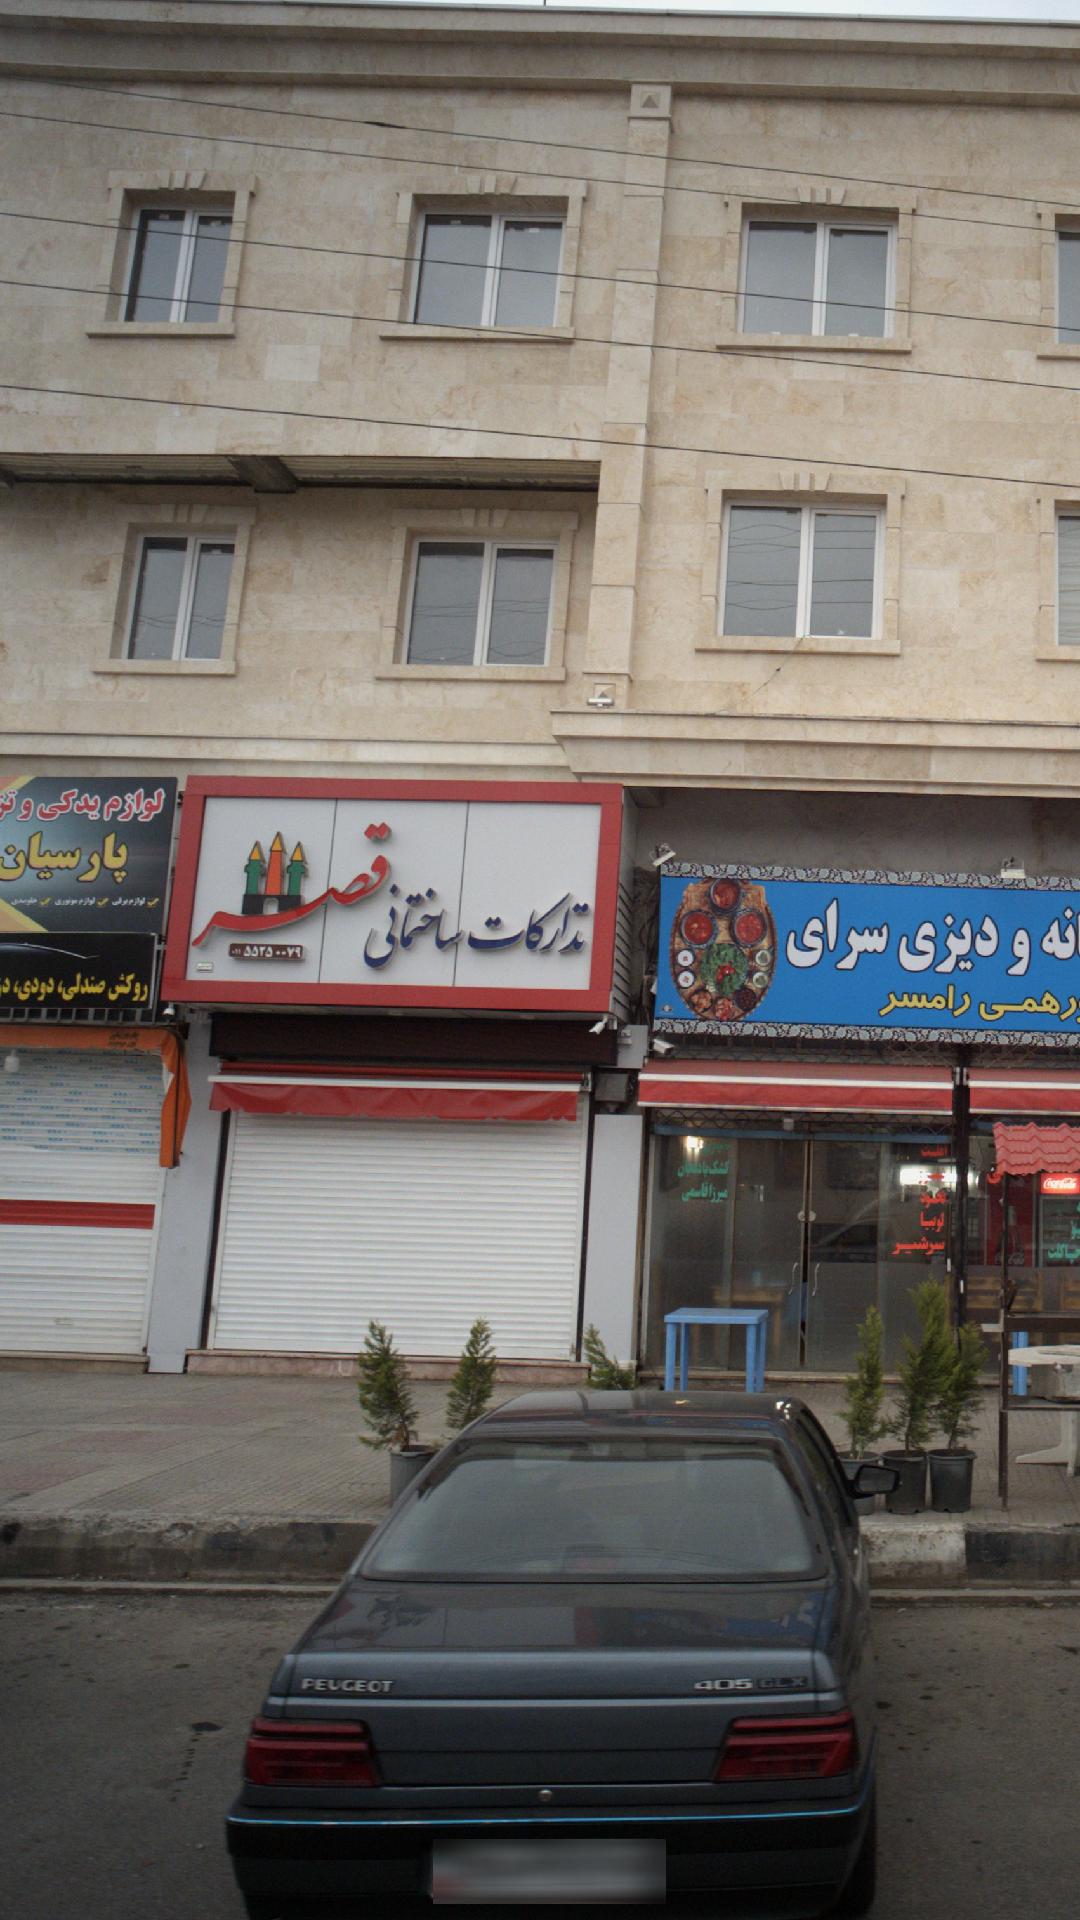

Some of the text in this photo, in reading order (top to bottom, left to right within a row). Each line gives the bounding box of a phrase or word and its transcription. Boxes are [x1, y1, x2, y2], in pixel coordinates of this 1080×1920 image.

[17, 798, 34, 821] و
[37, 789, 101, 820] یدکی
[103, 789, 165, 821] لوازم
[0, 831, 129, 884] پارسیان
[192, 822, 391, 947] قصر
[364, 884, 465, 970] ساختمانی
[467, 892, 590, 954] تدارکات
[786, 898, 889, 971] سرای
[899, 914, 1000, 973] دیزی
[1006, 928, 1031, 976] و
[108, 973, 148, 1001] روکش
[878, 984, 972, 1018] رامسر
[301, 1678, 393, 1693] PEUGEOT
[694, 1678, 753, 1691] 405
